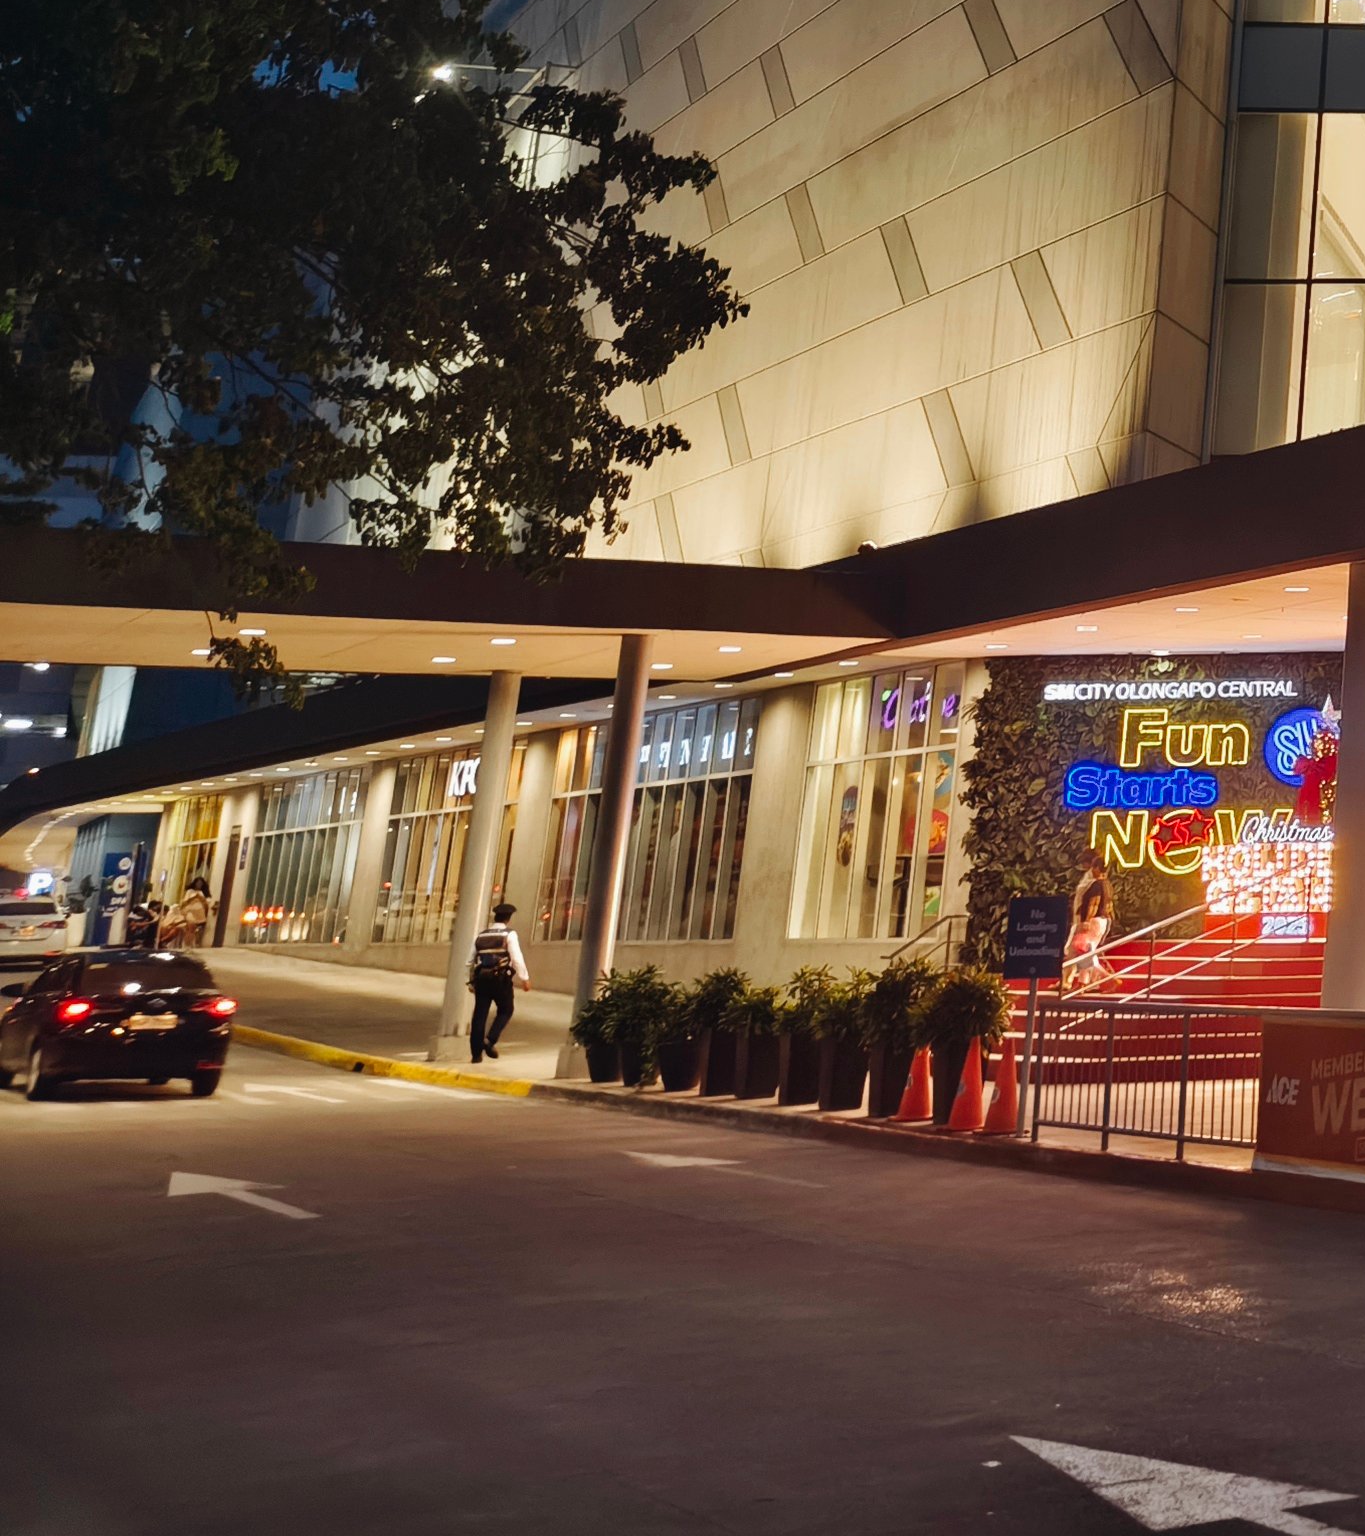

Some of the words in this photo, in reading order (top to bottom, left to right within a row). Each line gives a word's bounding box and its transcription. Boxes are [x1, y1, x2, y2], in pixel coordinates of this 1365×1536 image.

[1116, 681, 1217, 700] OLONGAPO
[1218, 680, 1298, 699] CENTRAL
[1120, 708, 1250, 768] Fun
[1066, 766, 1218, 808] Starts
[1242, 816, 1335, 844] Christmas
[28, 872, 54, 896] P
[1030, 909, 1046, 919] No
[1016, 921, 1058, 933] Loading
[1025, 933, 1046, 944] and
[1009, 946, 1060, 958] Unloading
[1266, 1073, 1300, 1106] ACE
